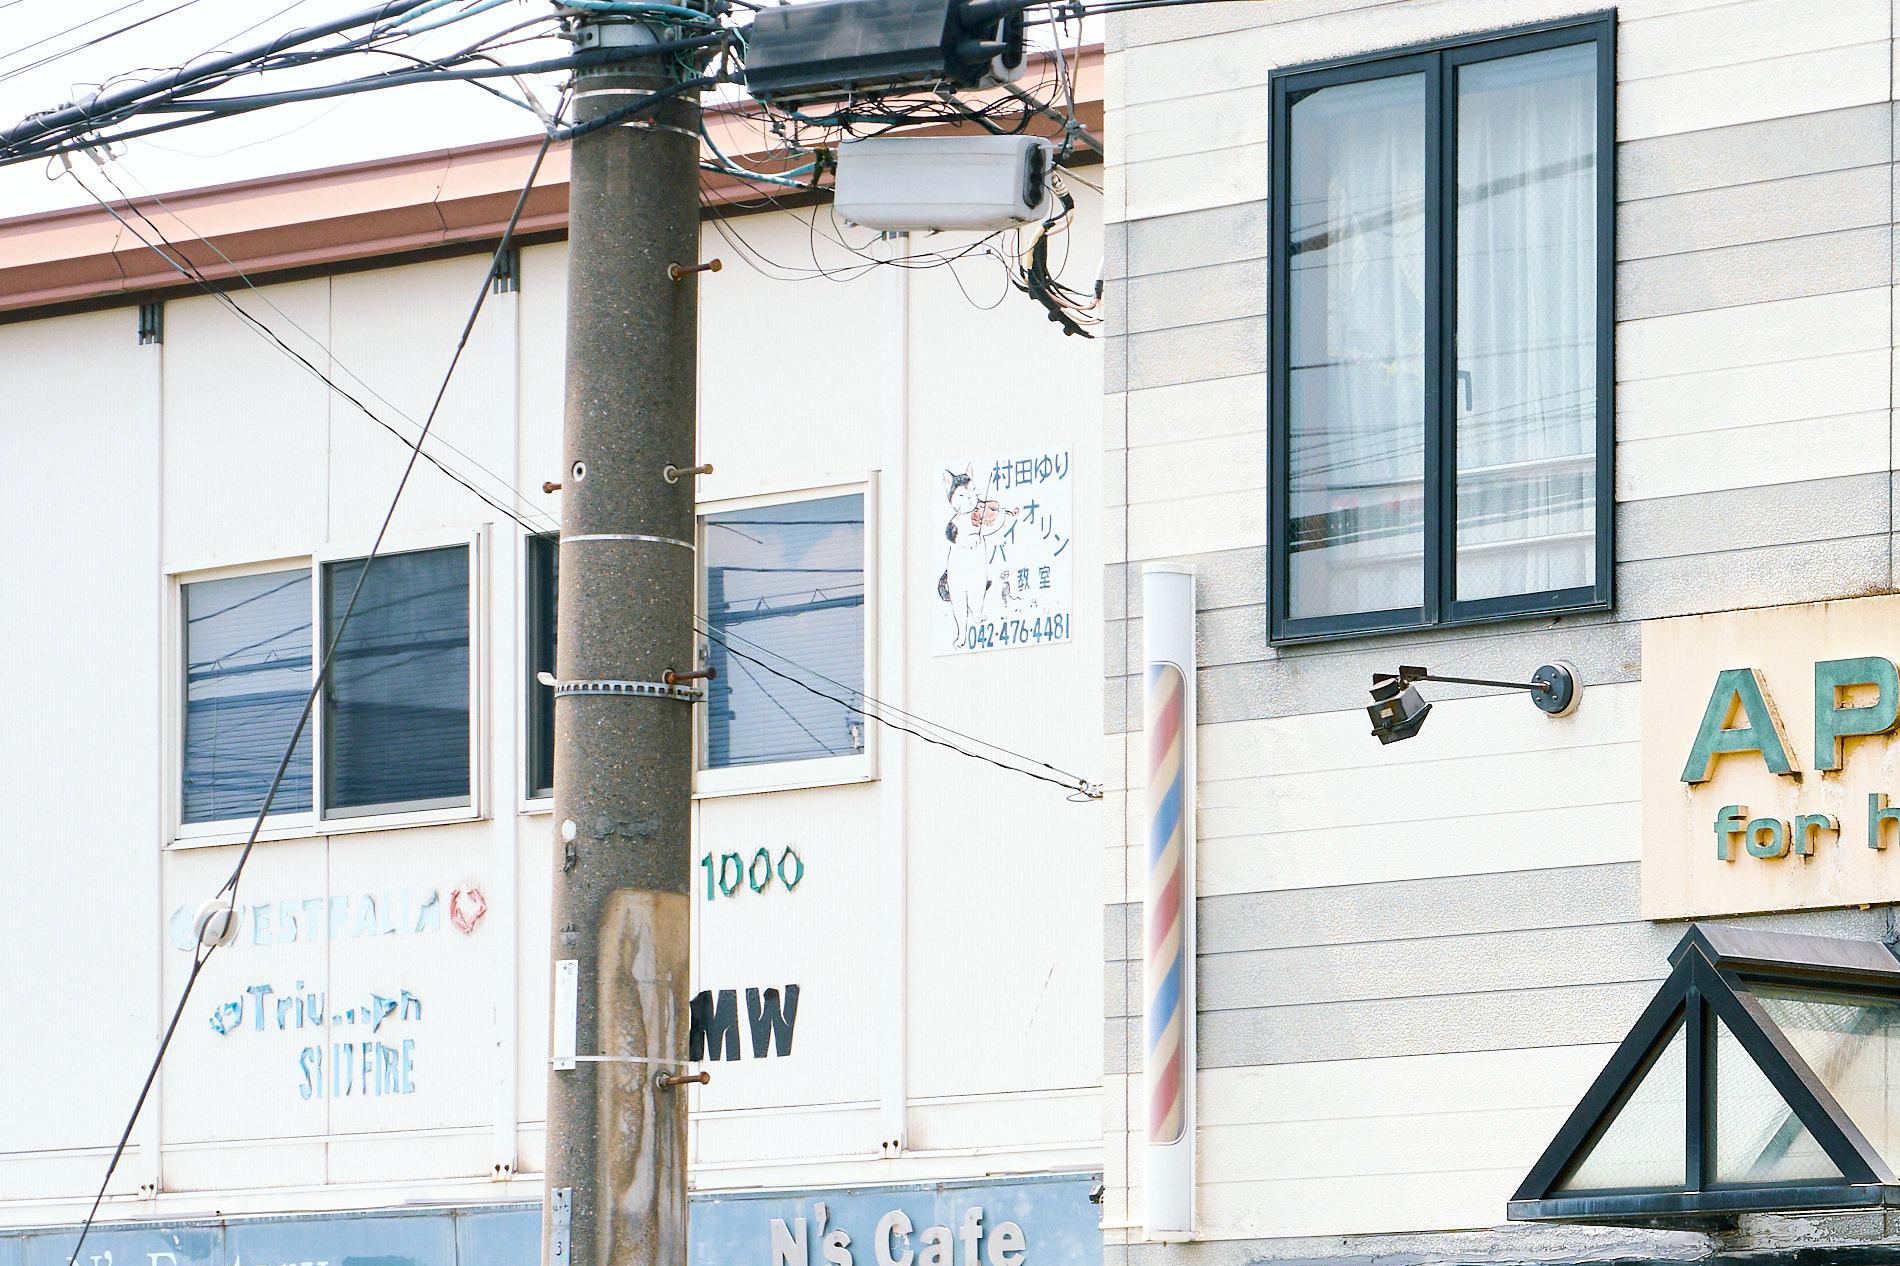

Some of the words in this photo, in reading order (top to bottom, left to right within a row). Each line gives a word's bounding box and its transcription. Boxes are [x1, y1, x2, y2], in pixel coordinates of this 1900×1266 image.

[992, 451, 1069, 491] 村田ゆり
[989, 499, 1069, 564] バイオリン
[1017, 566, 1051, 592] 教室
[1713, 804, 1840, 863] for
[701, 845, 805, 901] 1000
[226, 888, 441, 948] ESTFALIA
